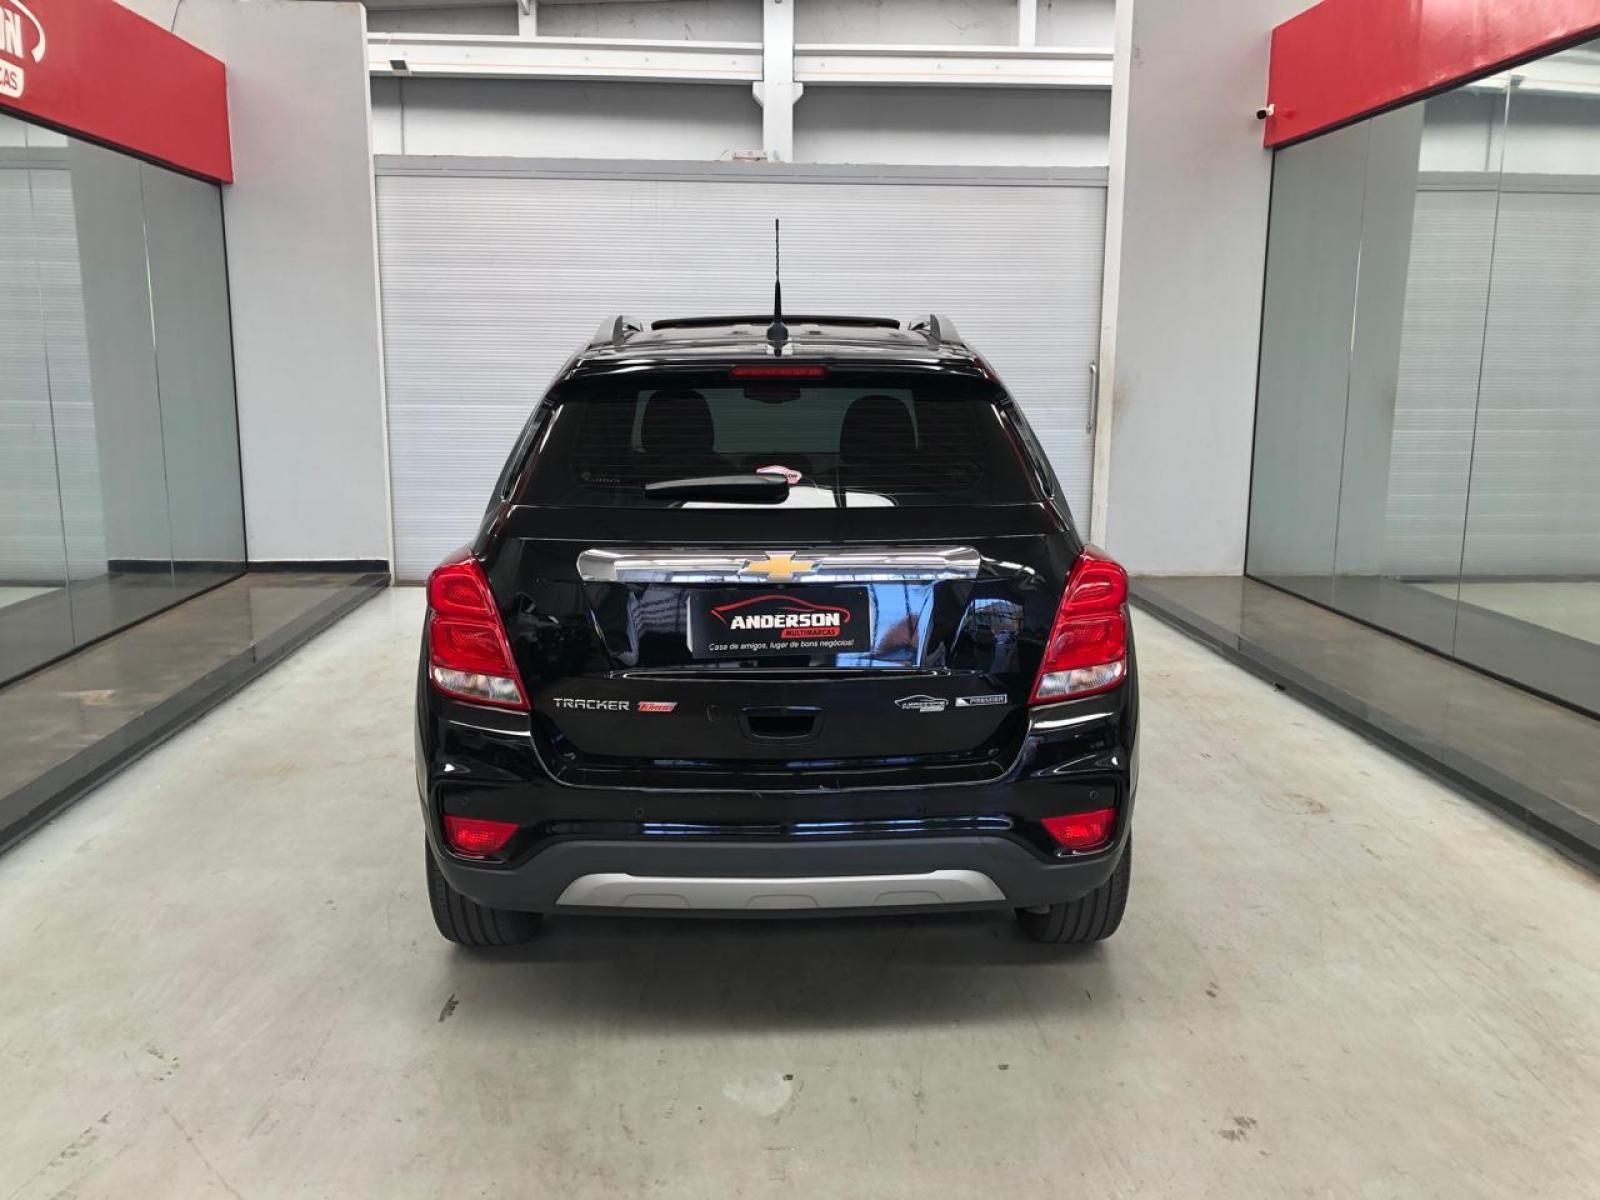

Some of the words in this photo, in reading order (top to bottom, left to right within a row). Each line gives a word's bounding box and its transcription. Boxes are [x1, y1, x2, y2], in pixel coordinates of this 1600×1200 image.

[730, 613, 841, 630] ANDERSON
[729, 642, 739, 650] de
[740, 640, 768, 652] amigos,
[769, 640, 789, 650] lugar
[789, 640, 799, 649] de
[800, 639, 819, 648] bons
[553, 697, 630, 711] TRACKER
